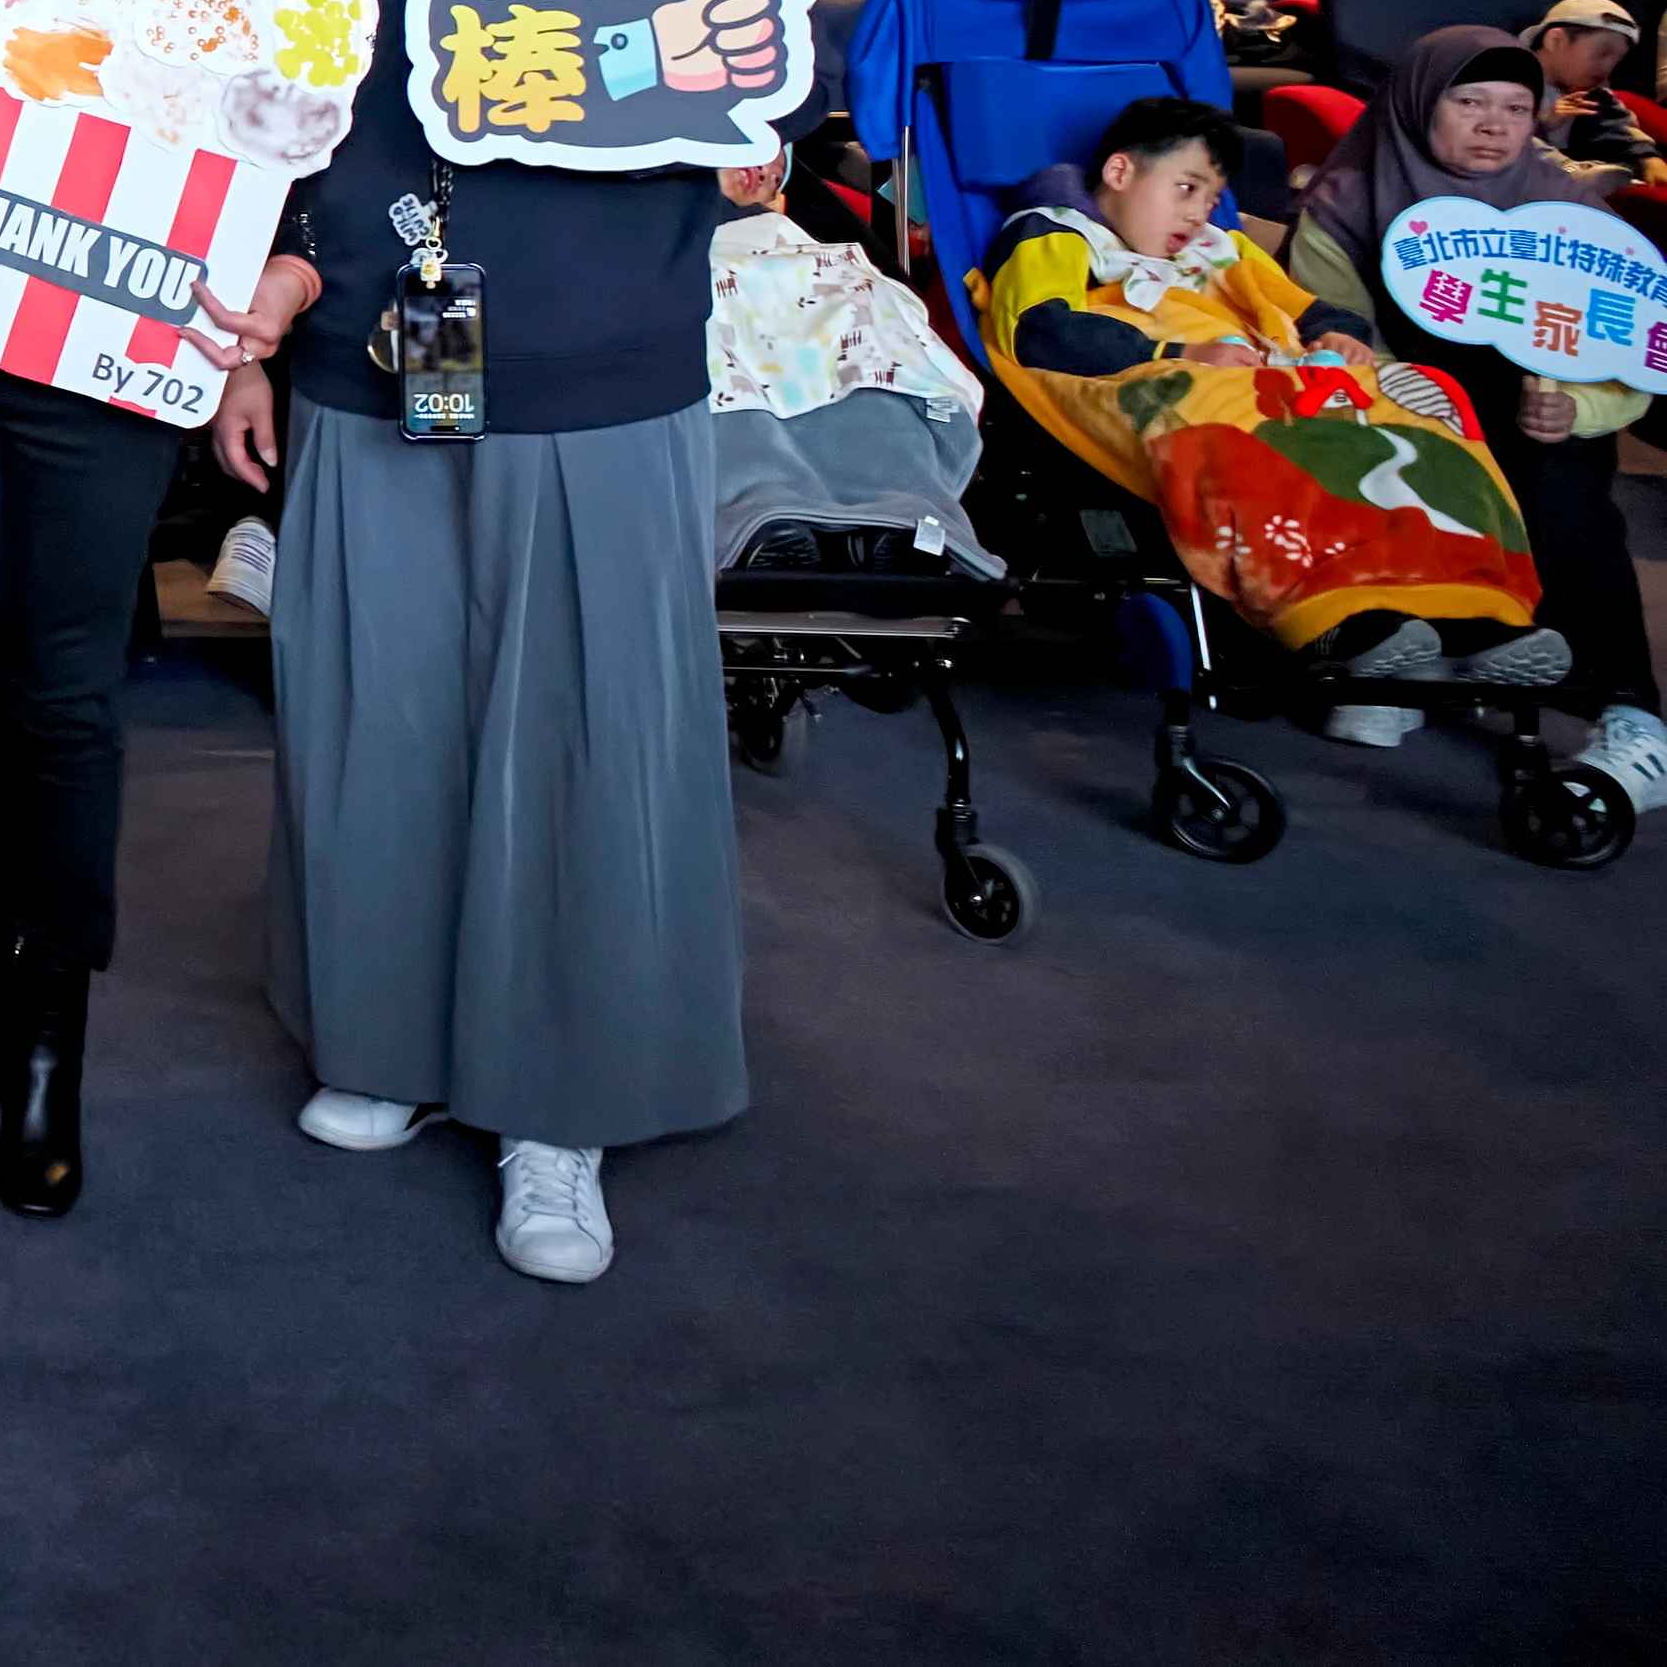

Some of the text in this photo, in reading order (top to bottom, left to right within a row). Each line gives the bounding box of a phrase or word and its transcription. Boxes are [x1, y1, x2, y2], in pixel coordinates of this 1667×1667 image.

[440, 4, 586, 133] 棒
[102, 239, 201, 313] YOU
[91, 354, 205, 414] By 702
[414, 393, 475, 412] 10:02
